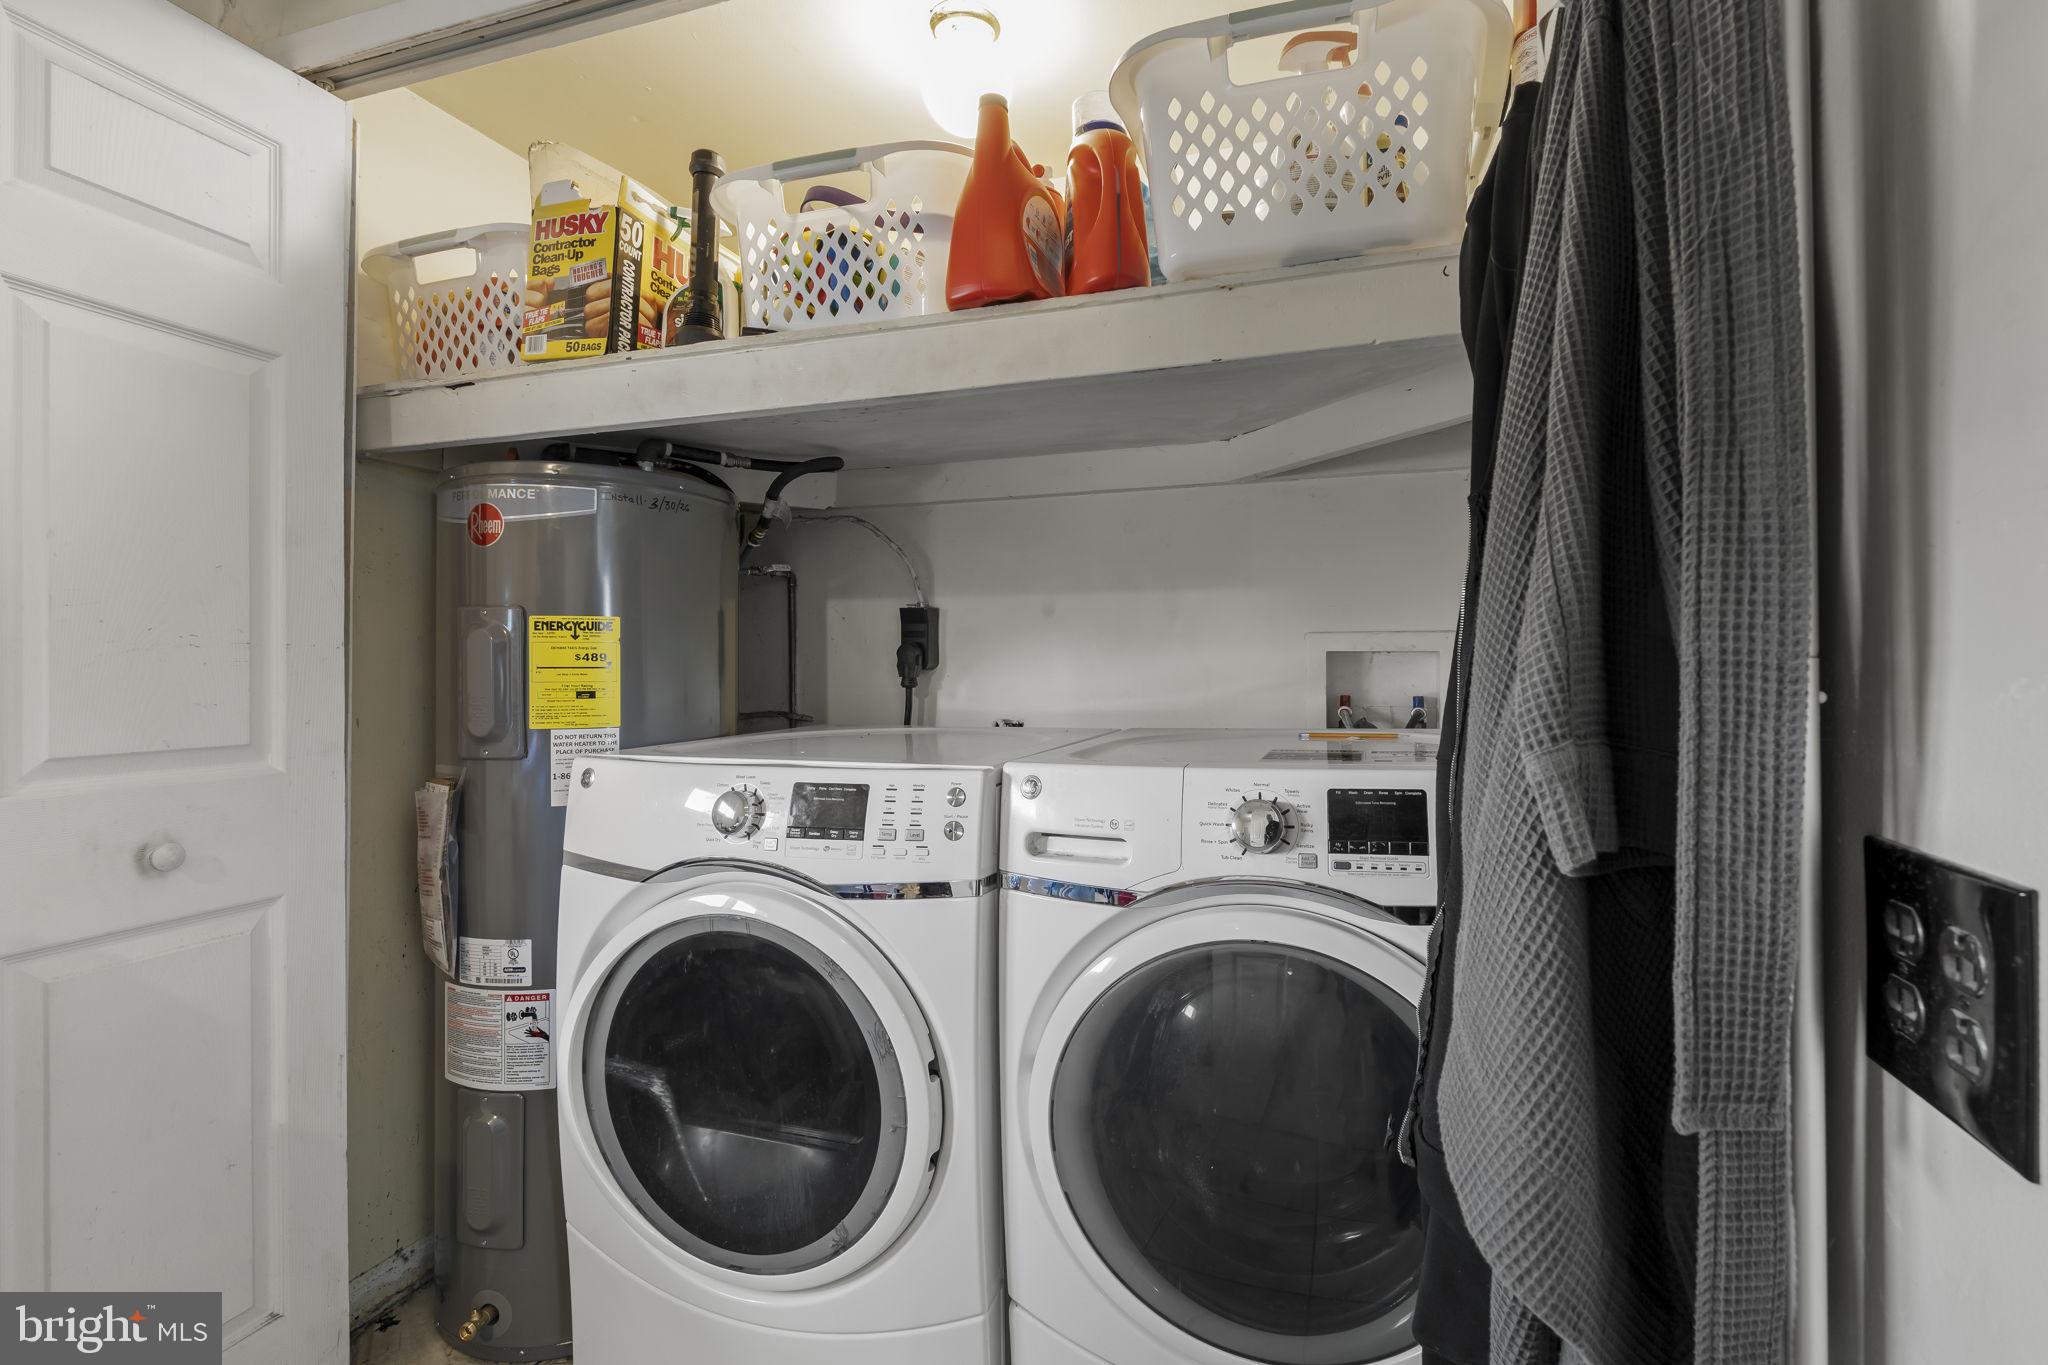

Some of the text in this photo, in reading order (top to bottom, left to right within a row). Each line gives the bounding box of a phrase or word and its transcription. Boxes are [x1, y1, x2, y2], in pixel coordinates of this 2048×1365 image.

[535, 211, 609, 241] HUSKY
[619, 213, 643, 261] 50 COUNT
[533, 237, 596, 253] Contractor
[532, 264, 560, 277] Bags
[573, 268, 604, 282] TOUGHER
[618, 259, 636, 329] CONTRACTOR
[640, 326, 656, 338] TRUE
[565, 341, 602, 352] 50 BAGS
[470, 504, 501, 540] Rheem
[534, 621, 614, 632] ENERGYGUIDE
[574, 653, 607, 662] $489
